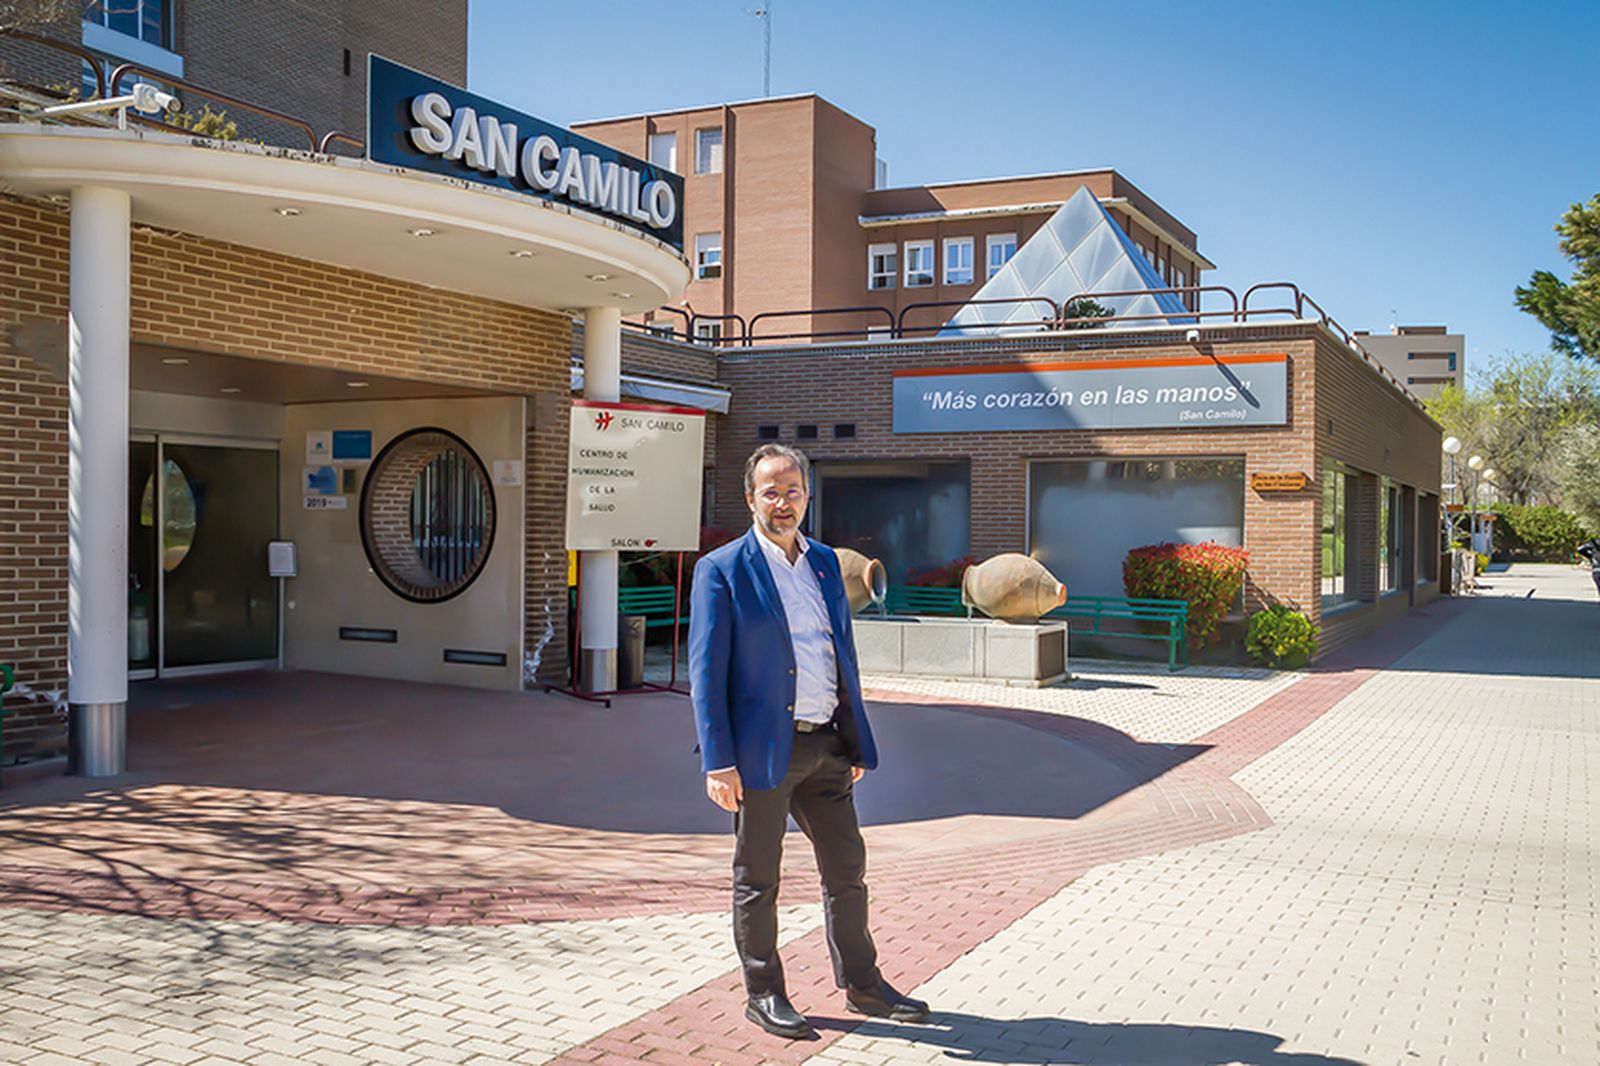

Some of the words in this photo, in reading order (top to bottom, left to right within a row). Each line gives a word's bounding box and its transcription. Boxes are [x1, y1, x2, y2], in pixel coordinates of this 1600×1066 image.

[410, 92, 517, 178] SAN
[521, 135, 676, 229] CAMILO
[983, 387, 1073, 409] corazón
[1080, 389, 1108, 406] en
[1115, 385, 1149, 404] las
[1179, 410, 1203, 421] (San
[1205, 409, 1248, 420] Camilo)
[621, 418, 642, 429] SAN
[647, 420, 685, 432] CAMILO
[579, 449, 614, 459] CENTRO
[617, 451, 628, 459] DE
[589, 485, 600, 494] DE
[605, 485, 616, 494] LA
[589, 503, 616, 512] SALUD
